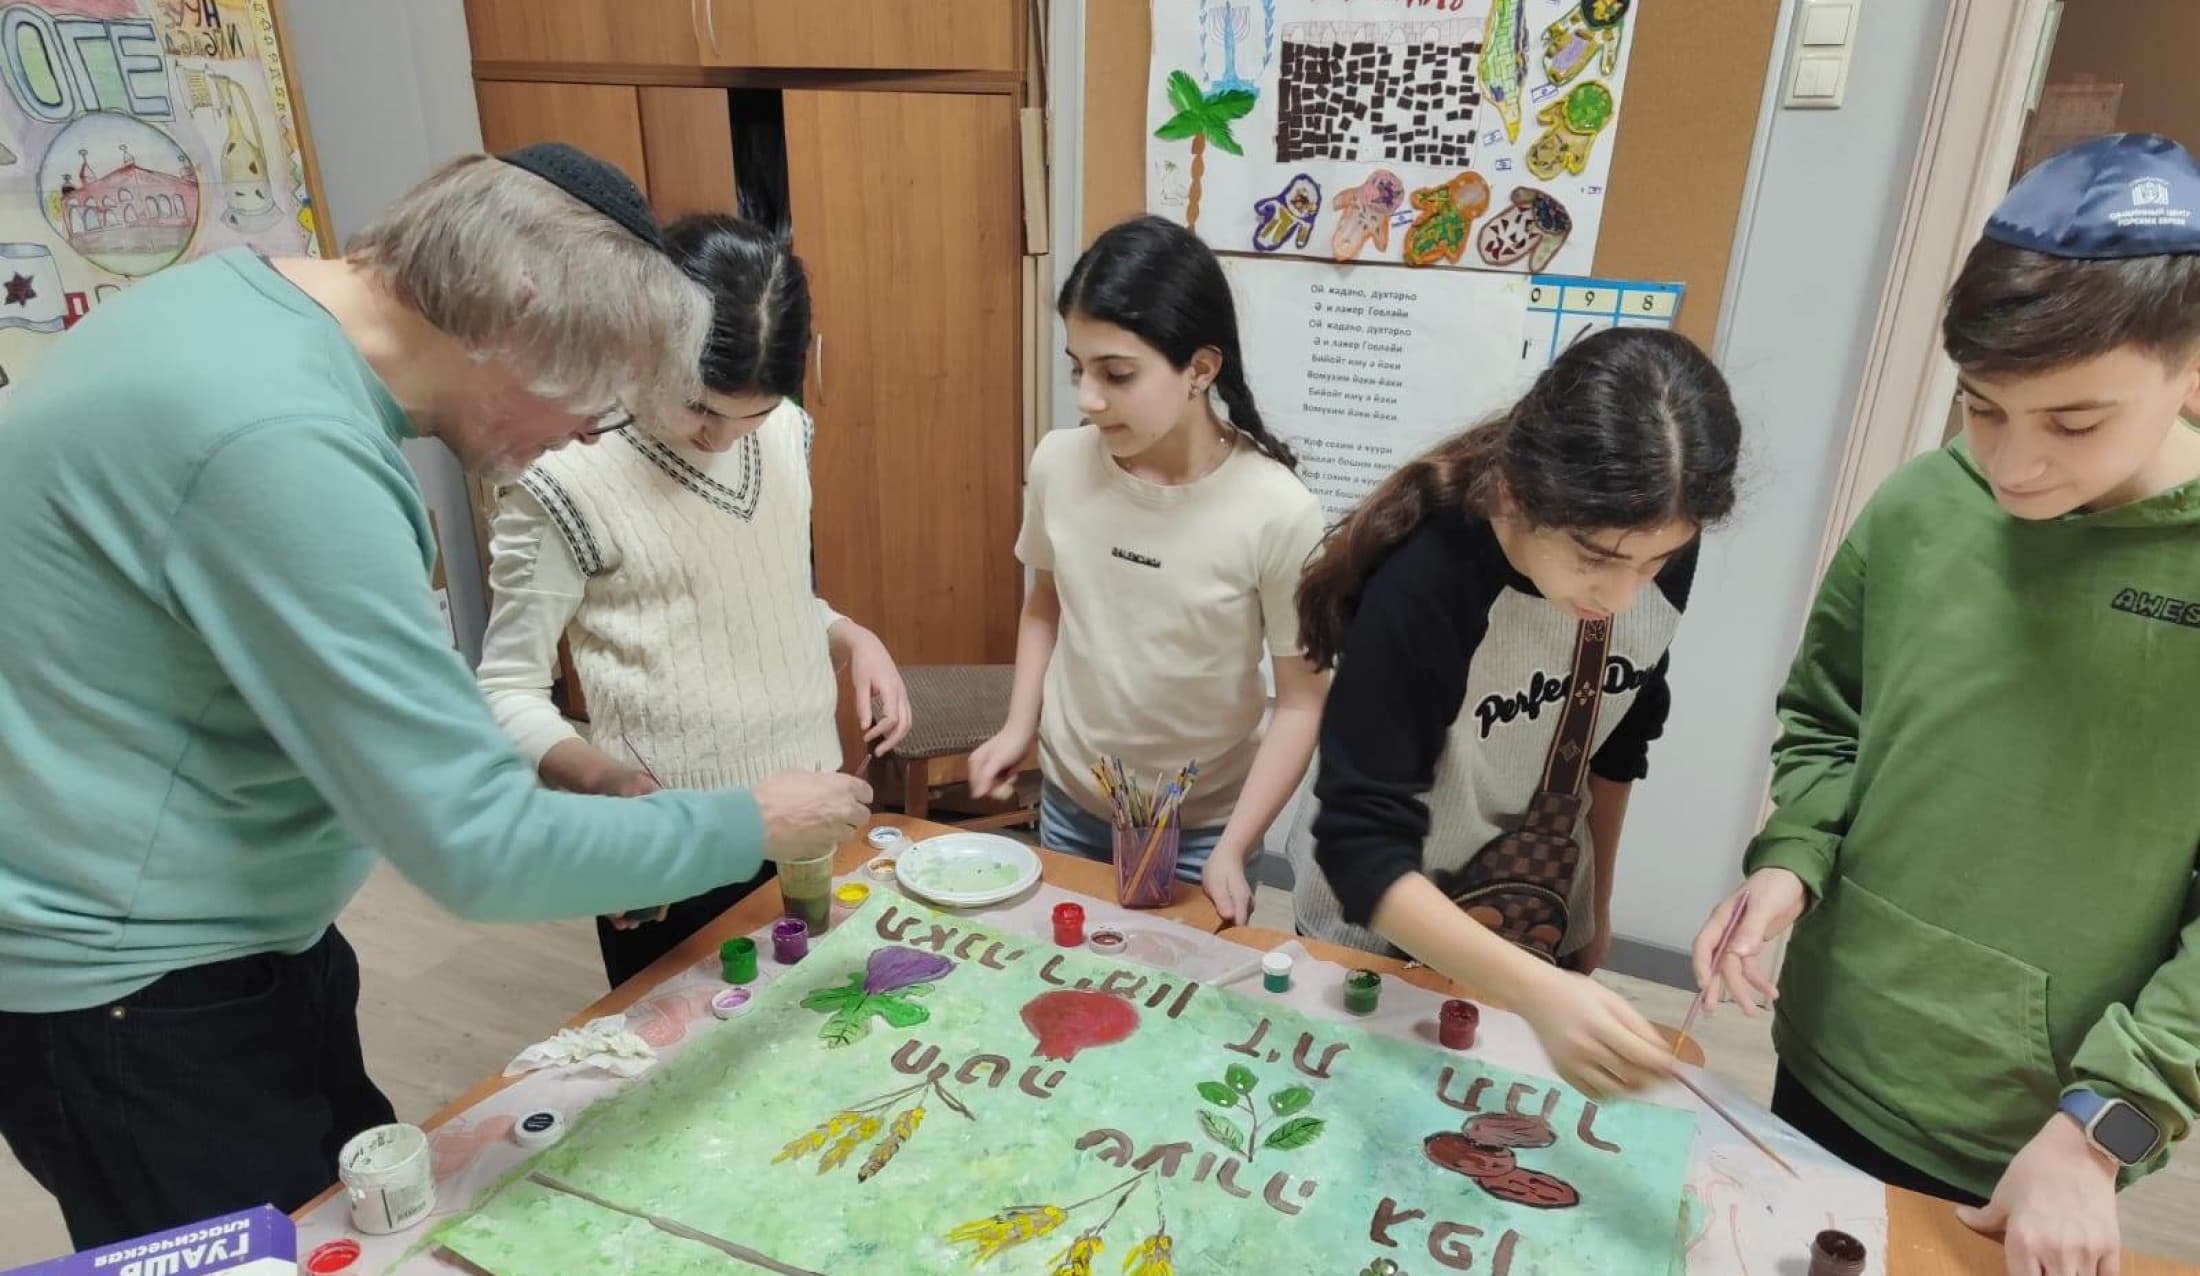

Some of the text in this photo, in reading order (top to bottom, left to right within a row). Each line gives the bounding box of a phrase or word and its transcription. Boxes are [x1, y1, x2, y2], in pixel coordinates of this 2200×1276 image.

[1585, 290, 1596, 307] 9
[1641, 294, 1655, 311] 8
[2111, 587, 2200, 628] AWES
[876, 905, 1025, 970] תאנה
[1040, 955, 1200, 1020] רימון
[890, 1038, 1067, 1100] חיטה
[1223, 1018, 1351, 1080] זית
[1436, 1067, 1622, 1154] תמר
[1074, 1128, 1318, 1216] שעורה
[94, 1217, 251, 1268] классическая
[119, 1232, 250, 1276] ГУАШЬ
[1369, 1196, 1519, 1276] גפן
